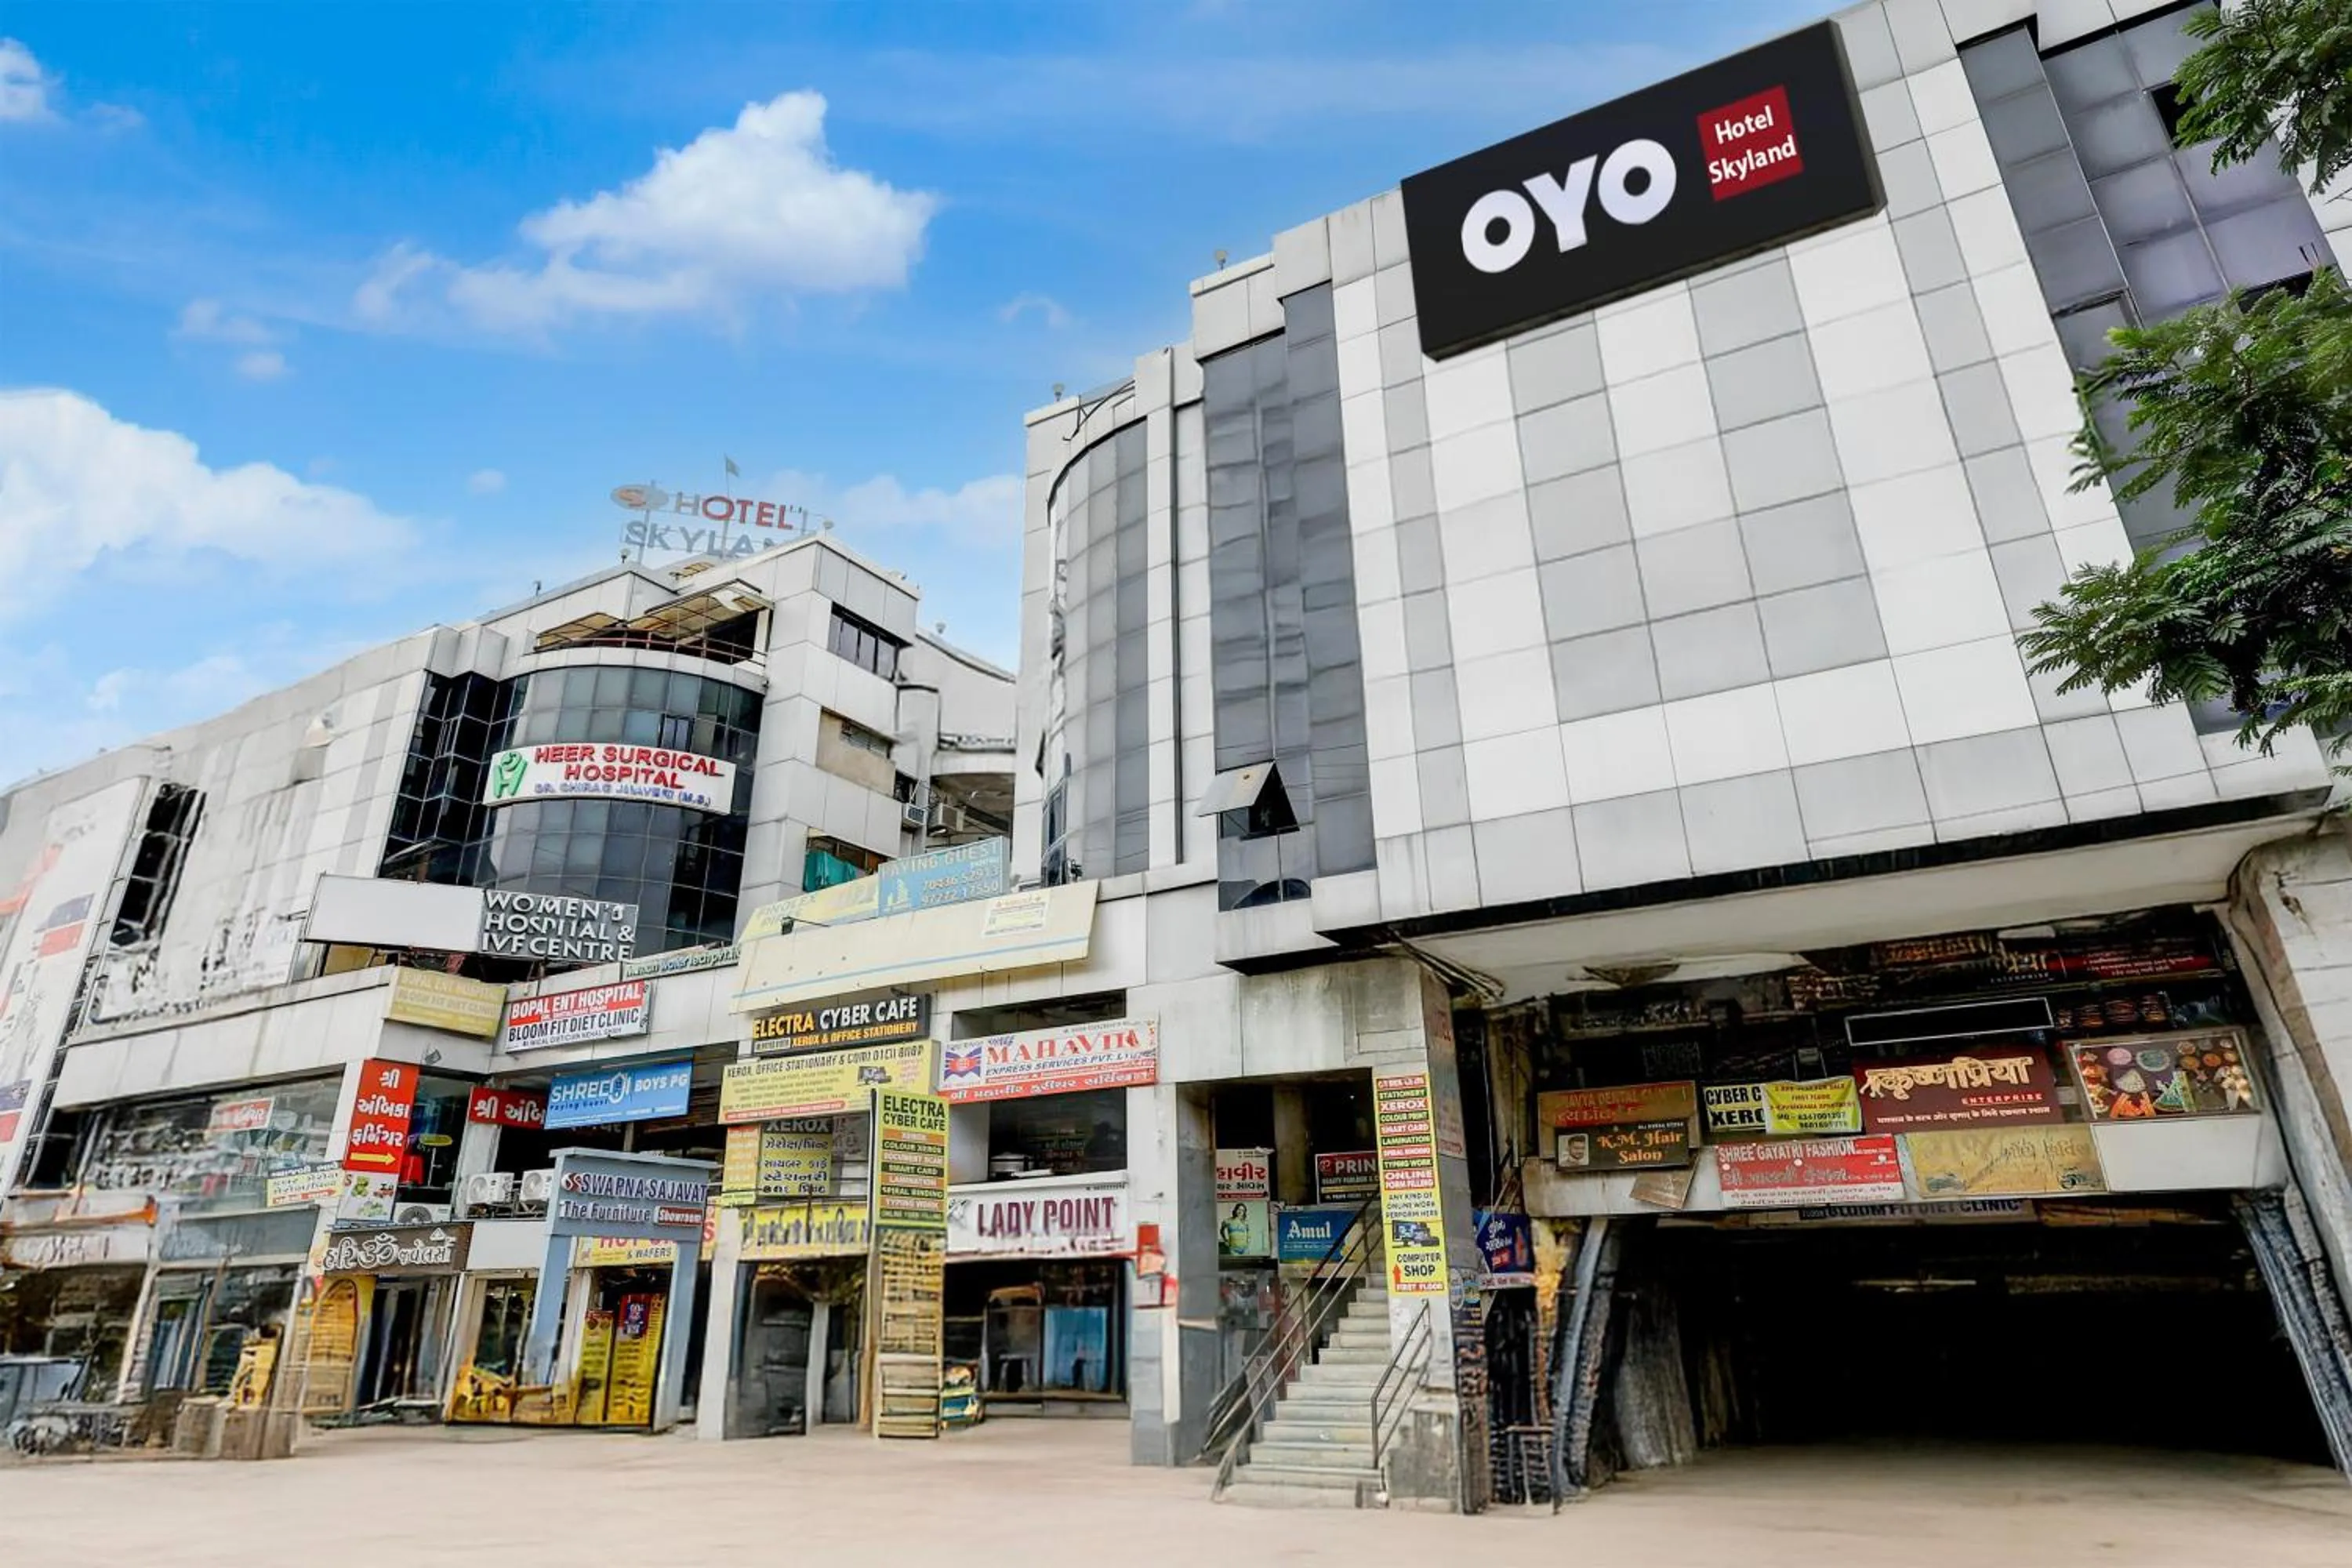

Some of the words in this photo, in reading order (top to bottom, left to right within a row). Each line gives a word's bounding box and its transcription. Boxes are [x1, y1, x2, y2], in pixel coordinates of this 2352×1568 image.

[1715, 104, 1774, 144] Hotel
[1708, 134, 1797, 184] Skyland
[1461, 139, 1677, 274] OYO
[674, 491, 793, 530] HOTEL
[624, 519, 779, 559] SKYLA
[535, 746, 595, 764] HEER
[601, 746, 725, 778] SURGICAL
[564, 764, 686, 789] HOSPITAL
[945, 841, 999, 865] GUEST
[482, 931, 526, 954] IVF
[529, 936, 631, 962] CENTRE
[511, 996, 554, 1019] BOPAL
[553, 993, 578, 1011] ENT
[578, 982, 641, 1009] HOSPITAL
[509, 1022, 549, 1042] BLOOM
[550, 1018, 570, 1035] FIT
[571, 1013, 598, 1032] DIET
[598, 1007, 640, 1029] CLINIC
[752, 1011, 815, 1040] ELECTRA
[819, 1004, 870, 1030] CYBER
[875, 996, 919, 1022] CAFE
[792, 1035, 820, 1047] XEROX
[822, 1034, 829, 1044] &
[830, 1029, 862, 1044] OFFICE
[863, 1022, 919, 1040] STATIONERY
[755, 1061, 783, 1076] OFFICE
[985, 1063, 1033, 1076] EXPRESS
[1033, 1056, 1087, 1072] SERVICES
[379, 1068, 401, 1091] શ્રી
[634, 1076, 668, 1093] BOYS
[670, 1073, 688, 1088] PG
[1379, 1089, 1425, 1099] STATIONERY
[1704, 1087, 1748, 1106] CYBER
[1961, 1092, 2043, 1105] ENTERPRISE
[357, 1094, 410, 1119] અંબિકા
[474, 1095, 500, 1120] શ્રી
[883, 1095, 946, 1119] ELECTRA
[1380, 1100, 1426, 1112] XEROX
[767, 1119, 829, 1133] XEROX
[883, 1112, 917, 1129] CYBER
[920, 1117, 946, 1132] CAFE
[1381, 1113, 1407, 1122] COLOUR
[1407, 1111, 1428, 1120] PRINT
[1708, 1108, 1765, 1127] XERO
[1407, 1123, 1429, 1131] CARD
[1382, 1135, 1431, 1145] LAMINATION
[1596, 1131, 1641, 1149] K.M.
[1617, 1149, 1664, 1164] Salon
[1718, 1144, 1756, 1163] SHREE
[1756, 1142, 1804, 1161] GAYATRI
[1805, 1141, 1857, 1159] FASHION
[888, 1163, 915, 1174] SMART
[917, 1166, 938, 1175] CARD
[1335, 1157, 1377, 1175] PRIN
[1385, 1171, 1433, 1181] ONLINE
[882, 1186, 910, 1196] SPIRAL
[560, 1200, 590, 1218] The
[590, 1202, 651, 1222] Furniture
[1413, 1200, 1436, 1209] WORK
[1959, 1198, 2020, 1213] CLINIC
[658, 1209, 703, 1224] Showroom
[978, 1200, 1036, 1237] LADY
[1043, 1196, 1115, 1236] POINT
[1287, 1219, 1331, 1240] Amul
[635, 1247, 672, 1258] WAFERS
[1396, 1253, 1442, 1263] COMPUTER
[1404, 1264, 1436, 1277] SHOP
